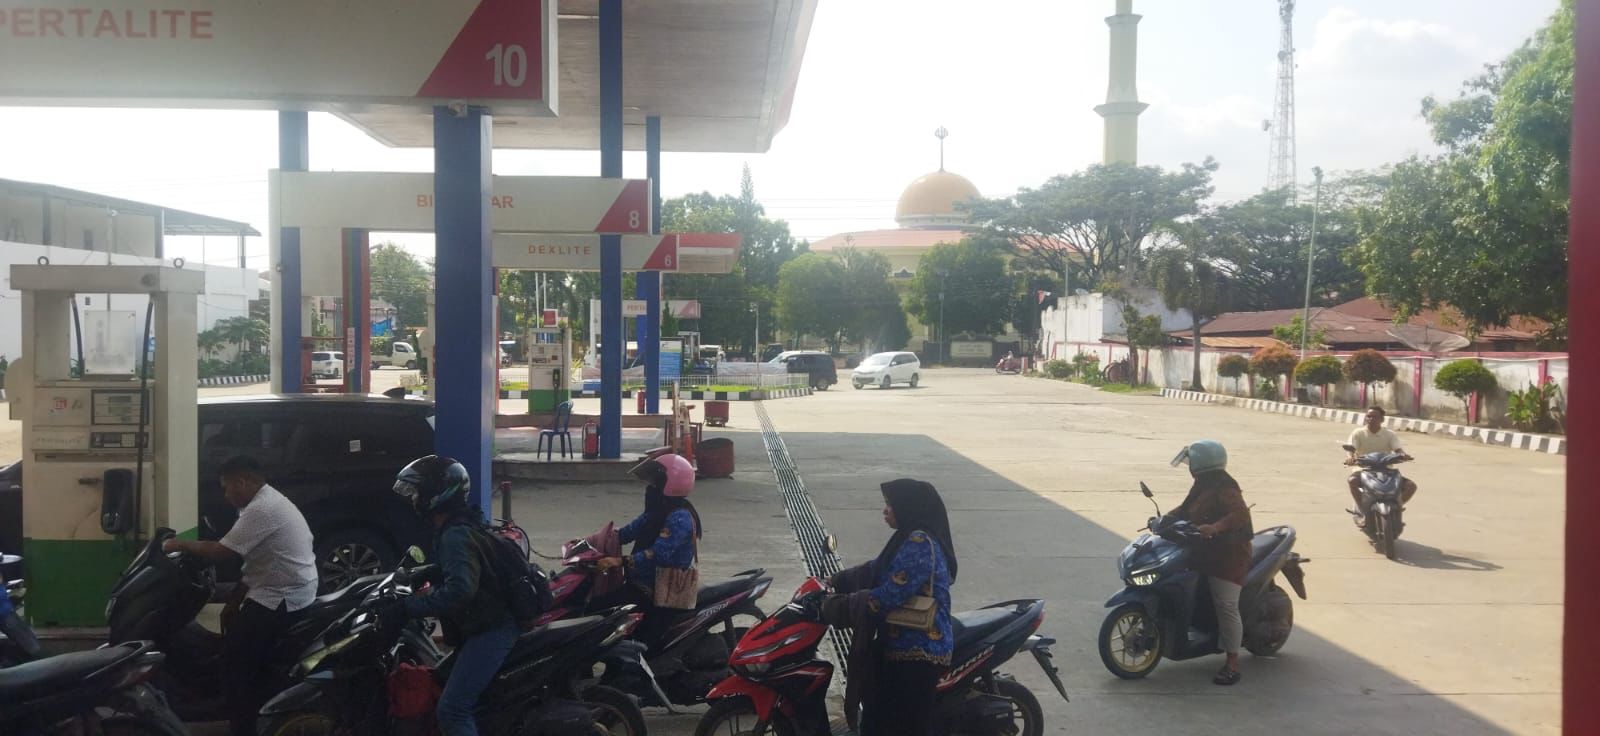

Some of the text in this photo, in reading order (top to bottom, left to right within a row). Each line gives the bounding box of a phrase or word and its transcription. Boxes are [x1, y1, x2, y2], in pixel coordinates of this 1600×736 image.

[485, 43, 527, 88] 10
[629, 210, 640, 229] 8
[528, 244, 592, 256] DEXLITE
[664, 254, 672, 267] 6
